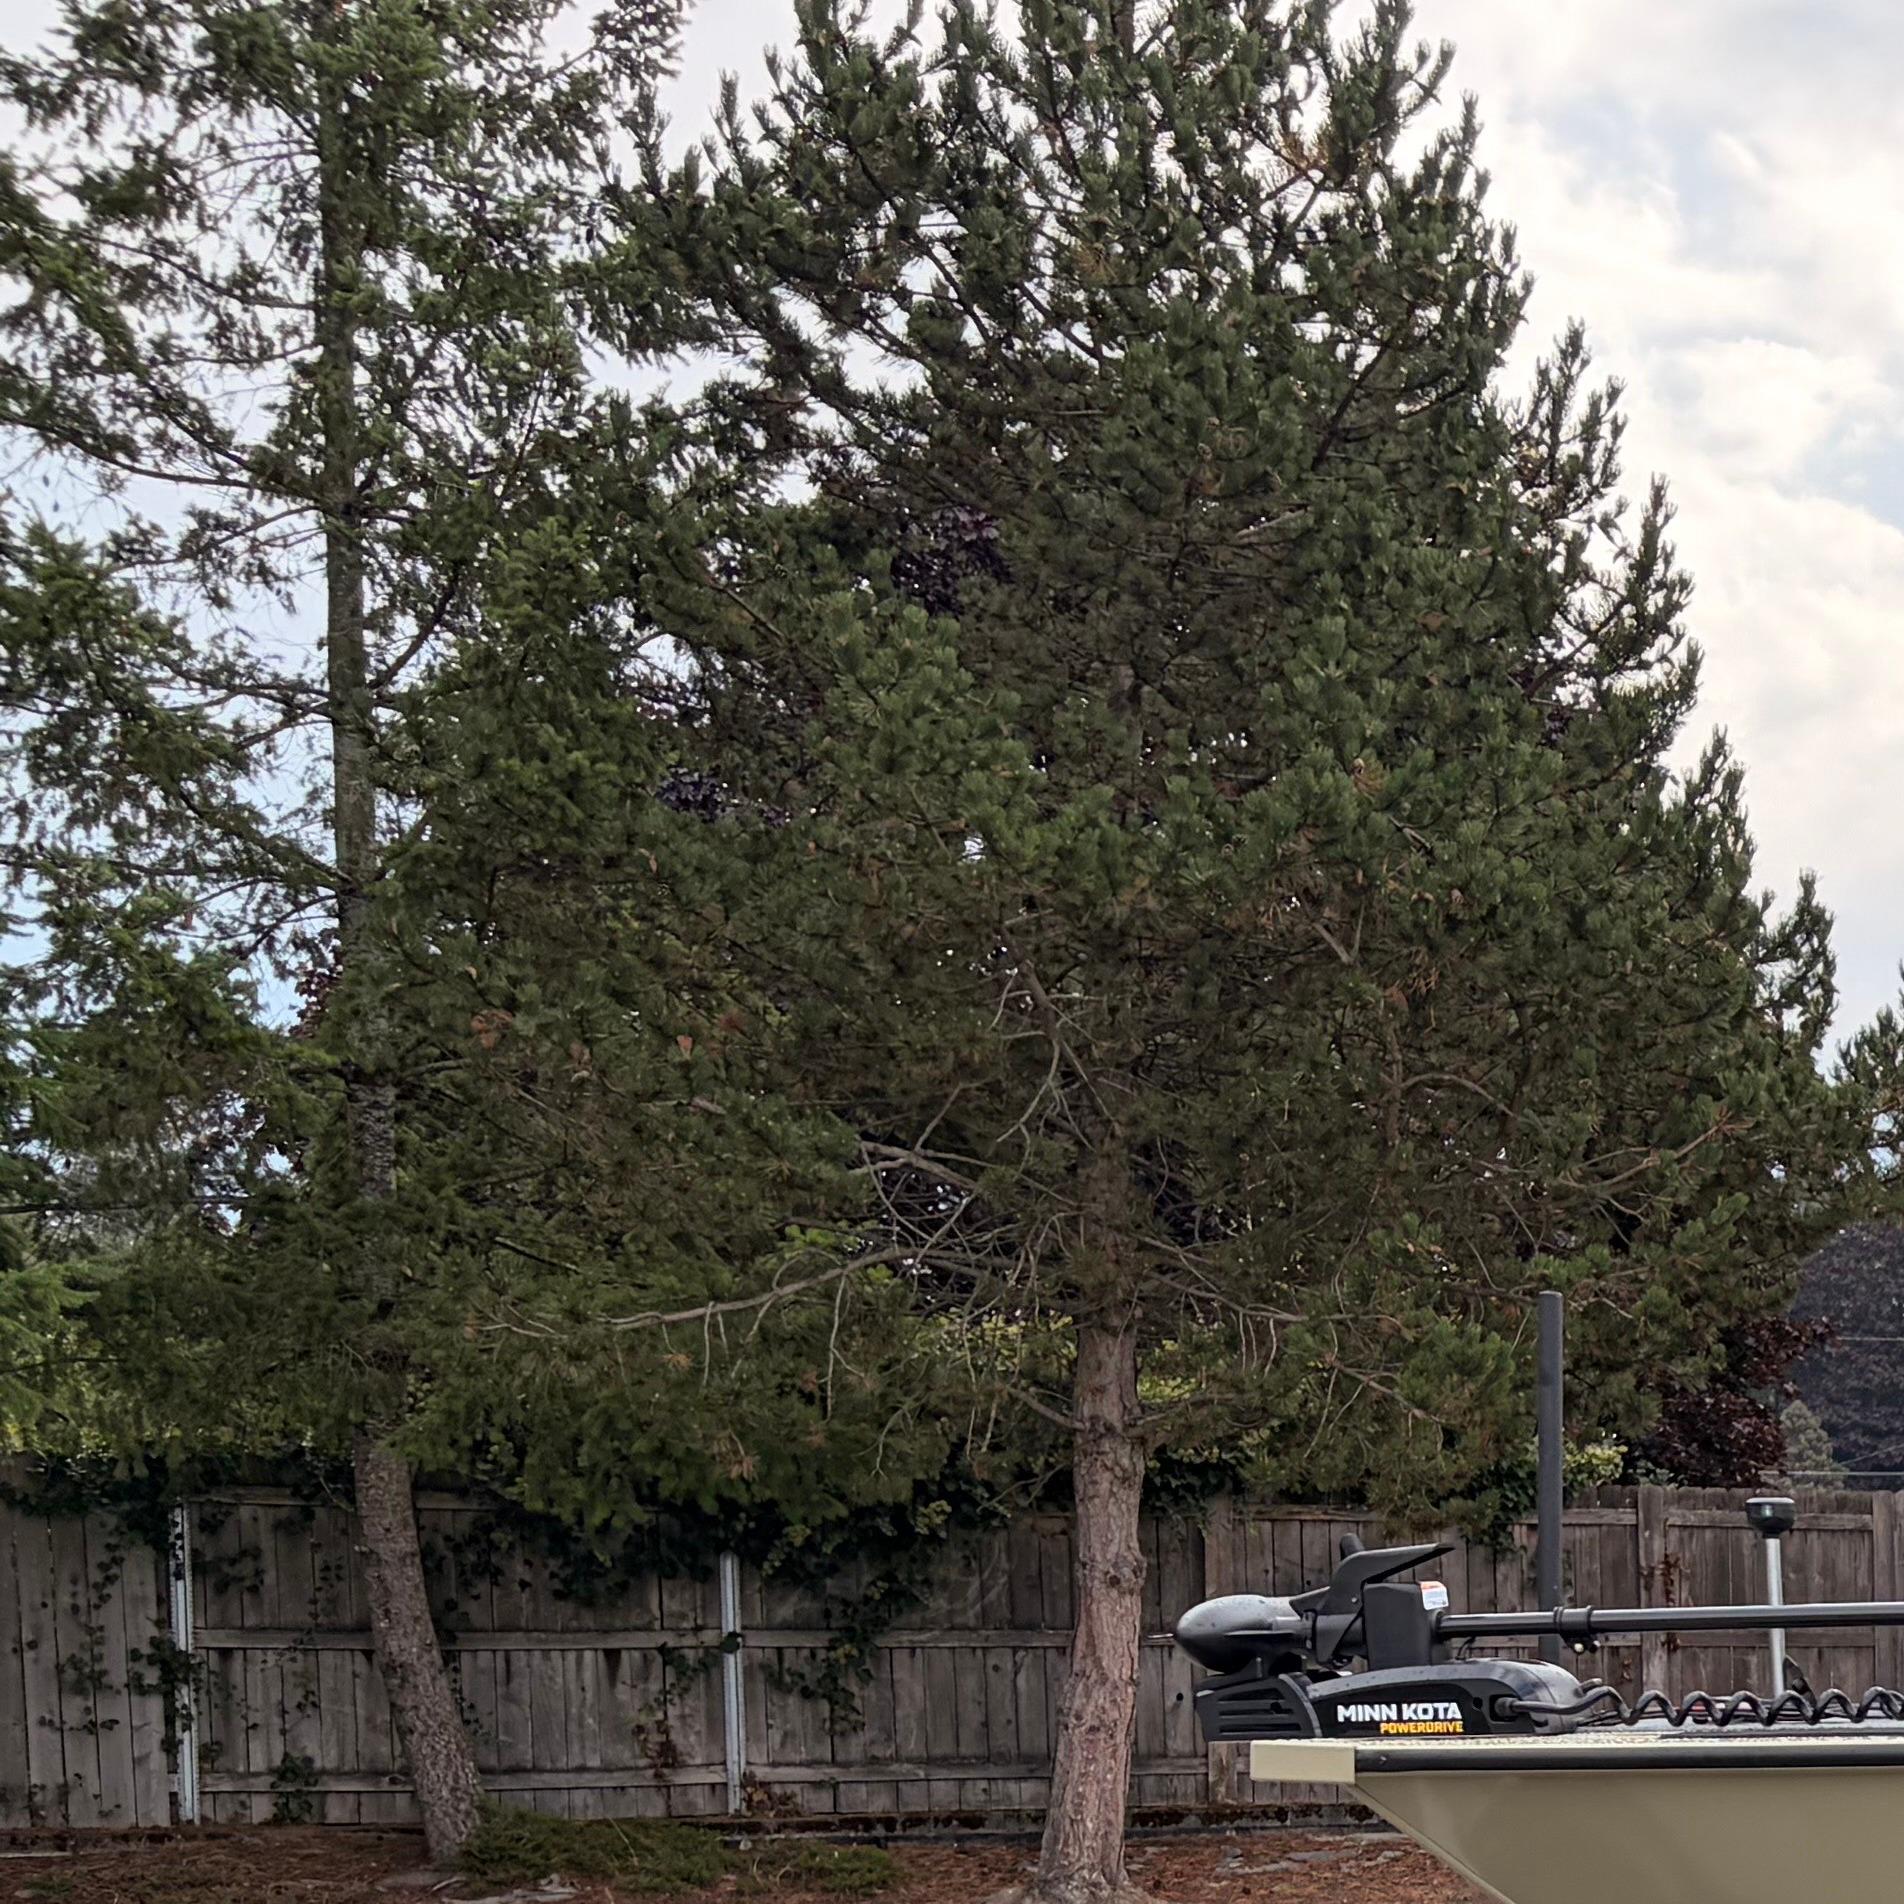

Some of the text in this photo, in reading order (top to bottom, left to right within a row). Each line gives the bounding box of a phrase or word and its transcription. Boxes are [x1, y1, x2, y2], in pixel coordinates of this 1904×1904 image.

[1337, 1702, 1462, 1722] MINN KOTA
[1380, 1721, 1464, 1734] POWERDRIVE
